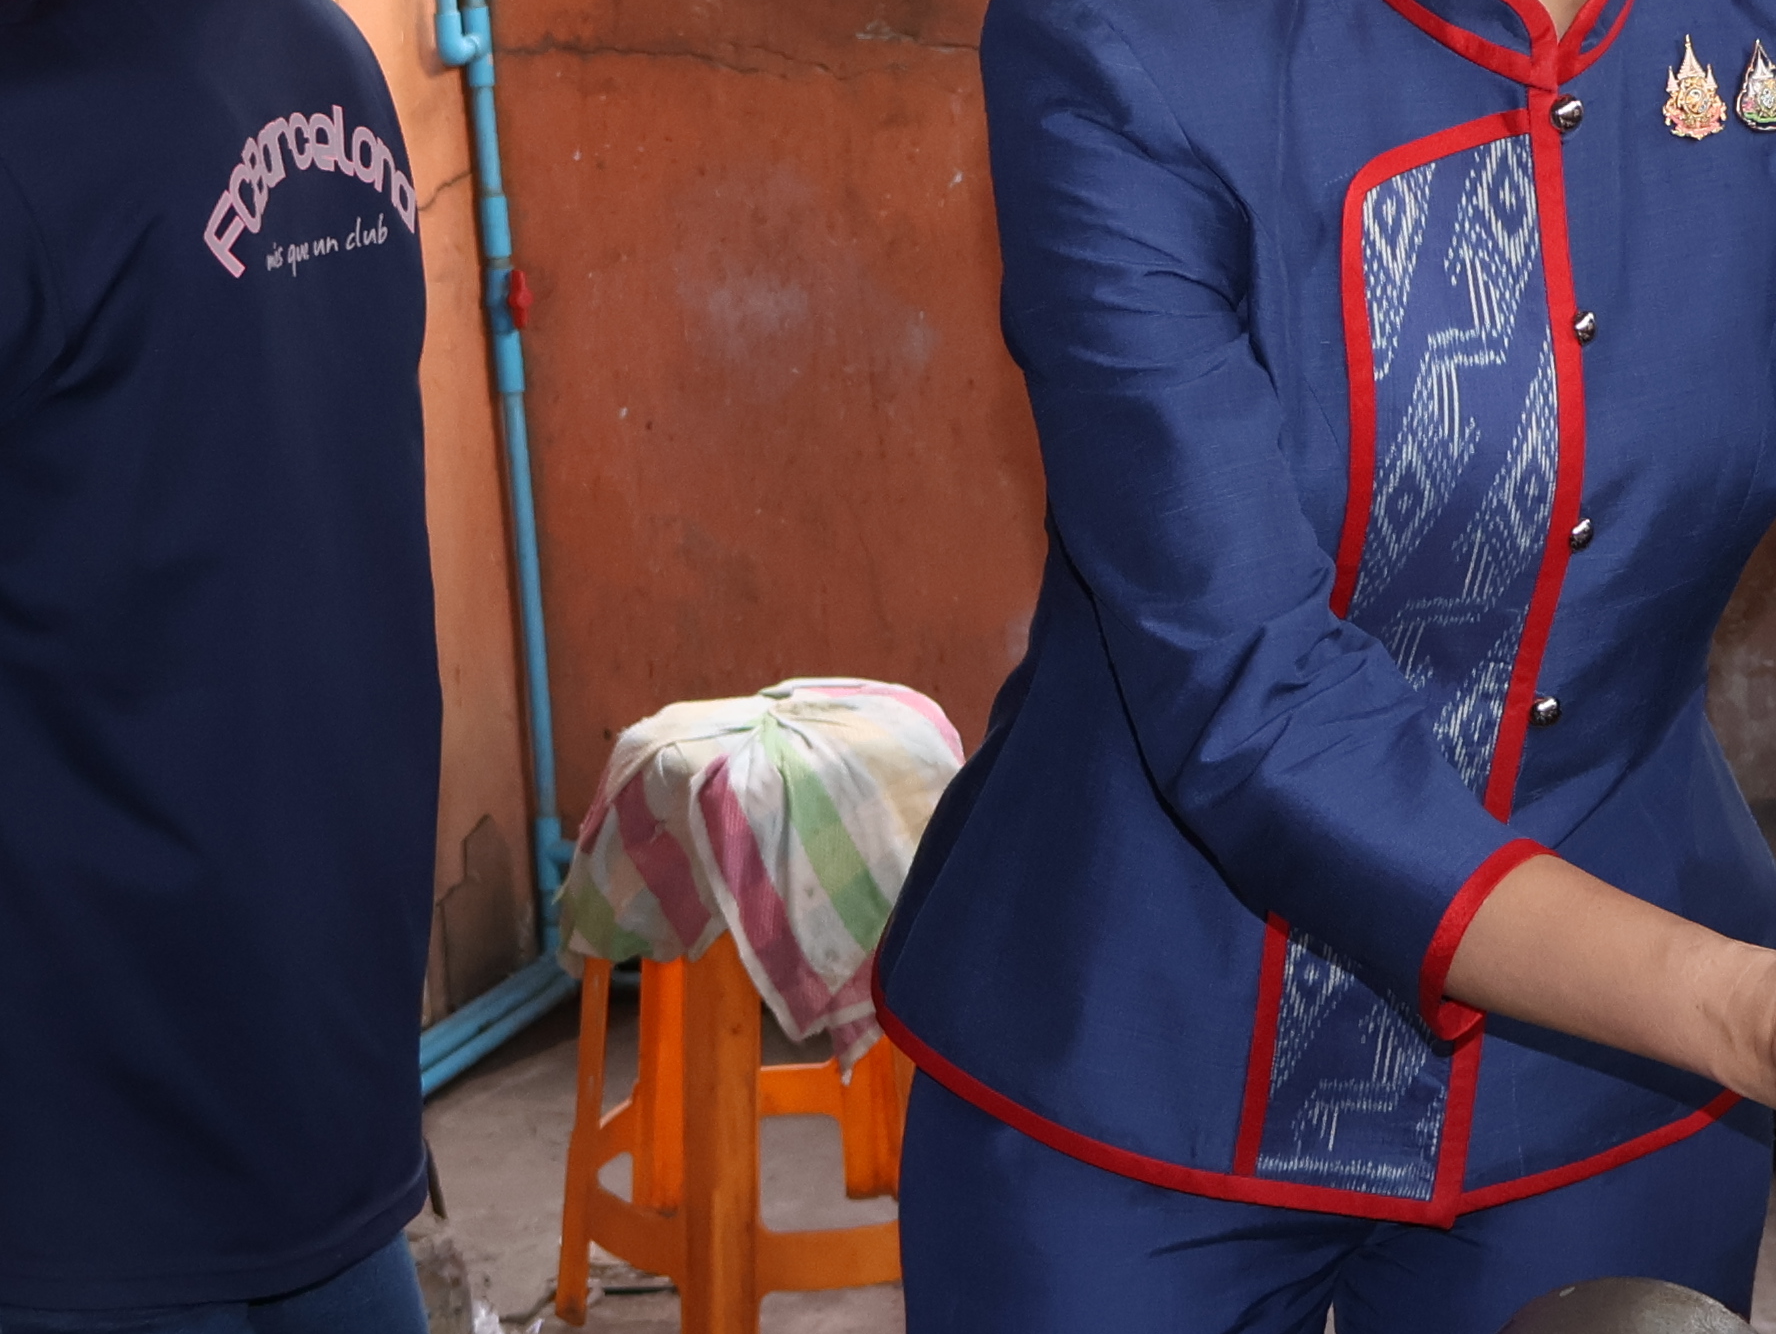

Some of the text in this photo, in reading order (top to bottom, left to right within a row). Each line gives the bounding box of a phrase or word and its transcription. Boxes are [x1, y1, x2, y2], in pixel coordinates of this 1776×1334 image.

[288, 242, 309, 277] que
[313, 237, 338, 257] un
[345, 214, 388, 250] club
